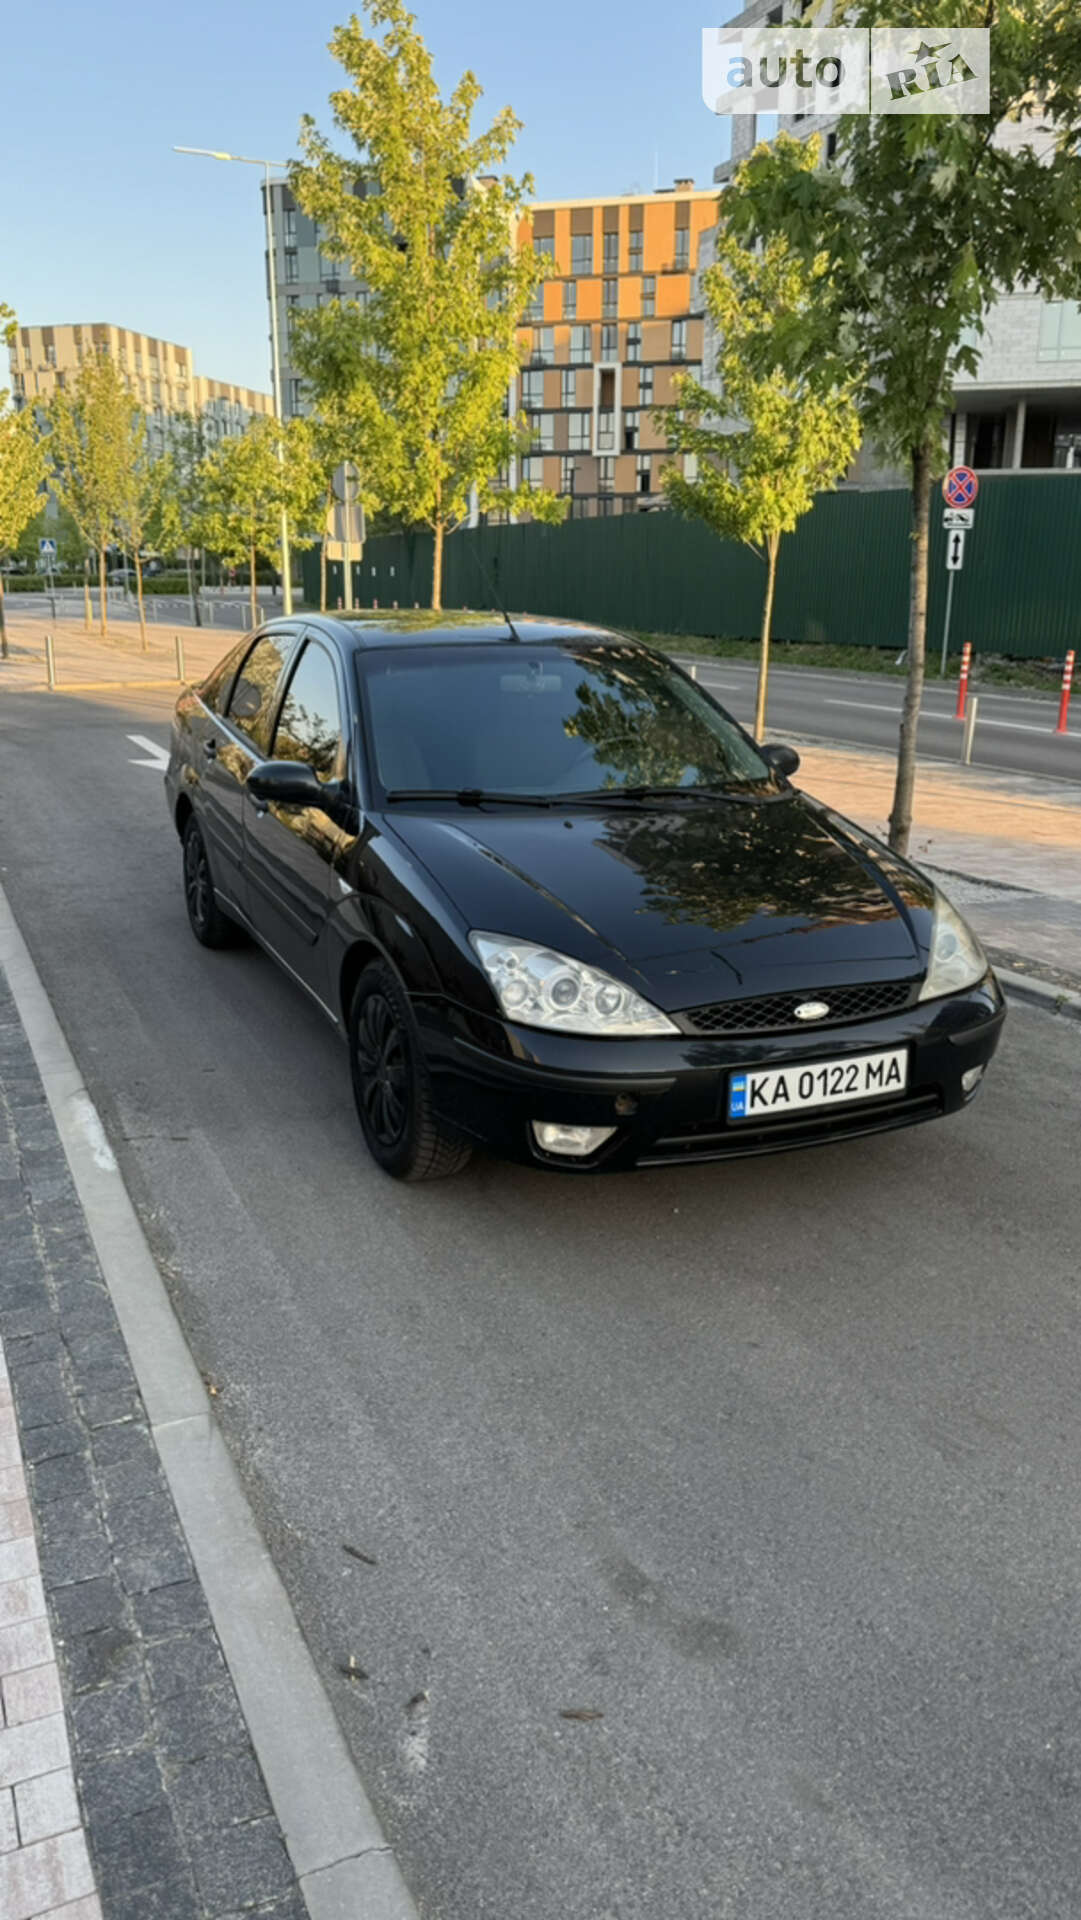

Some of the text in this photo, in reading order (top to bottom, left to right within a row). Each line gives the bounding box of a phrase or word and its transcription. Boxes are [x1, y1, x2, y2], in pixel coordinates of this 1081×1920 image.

[750, 1057, 901, 1108] KA 0122 MA
[731, 1102, 745, 1111] UA
